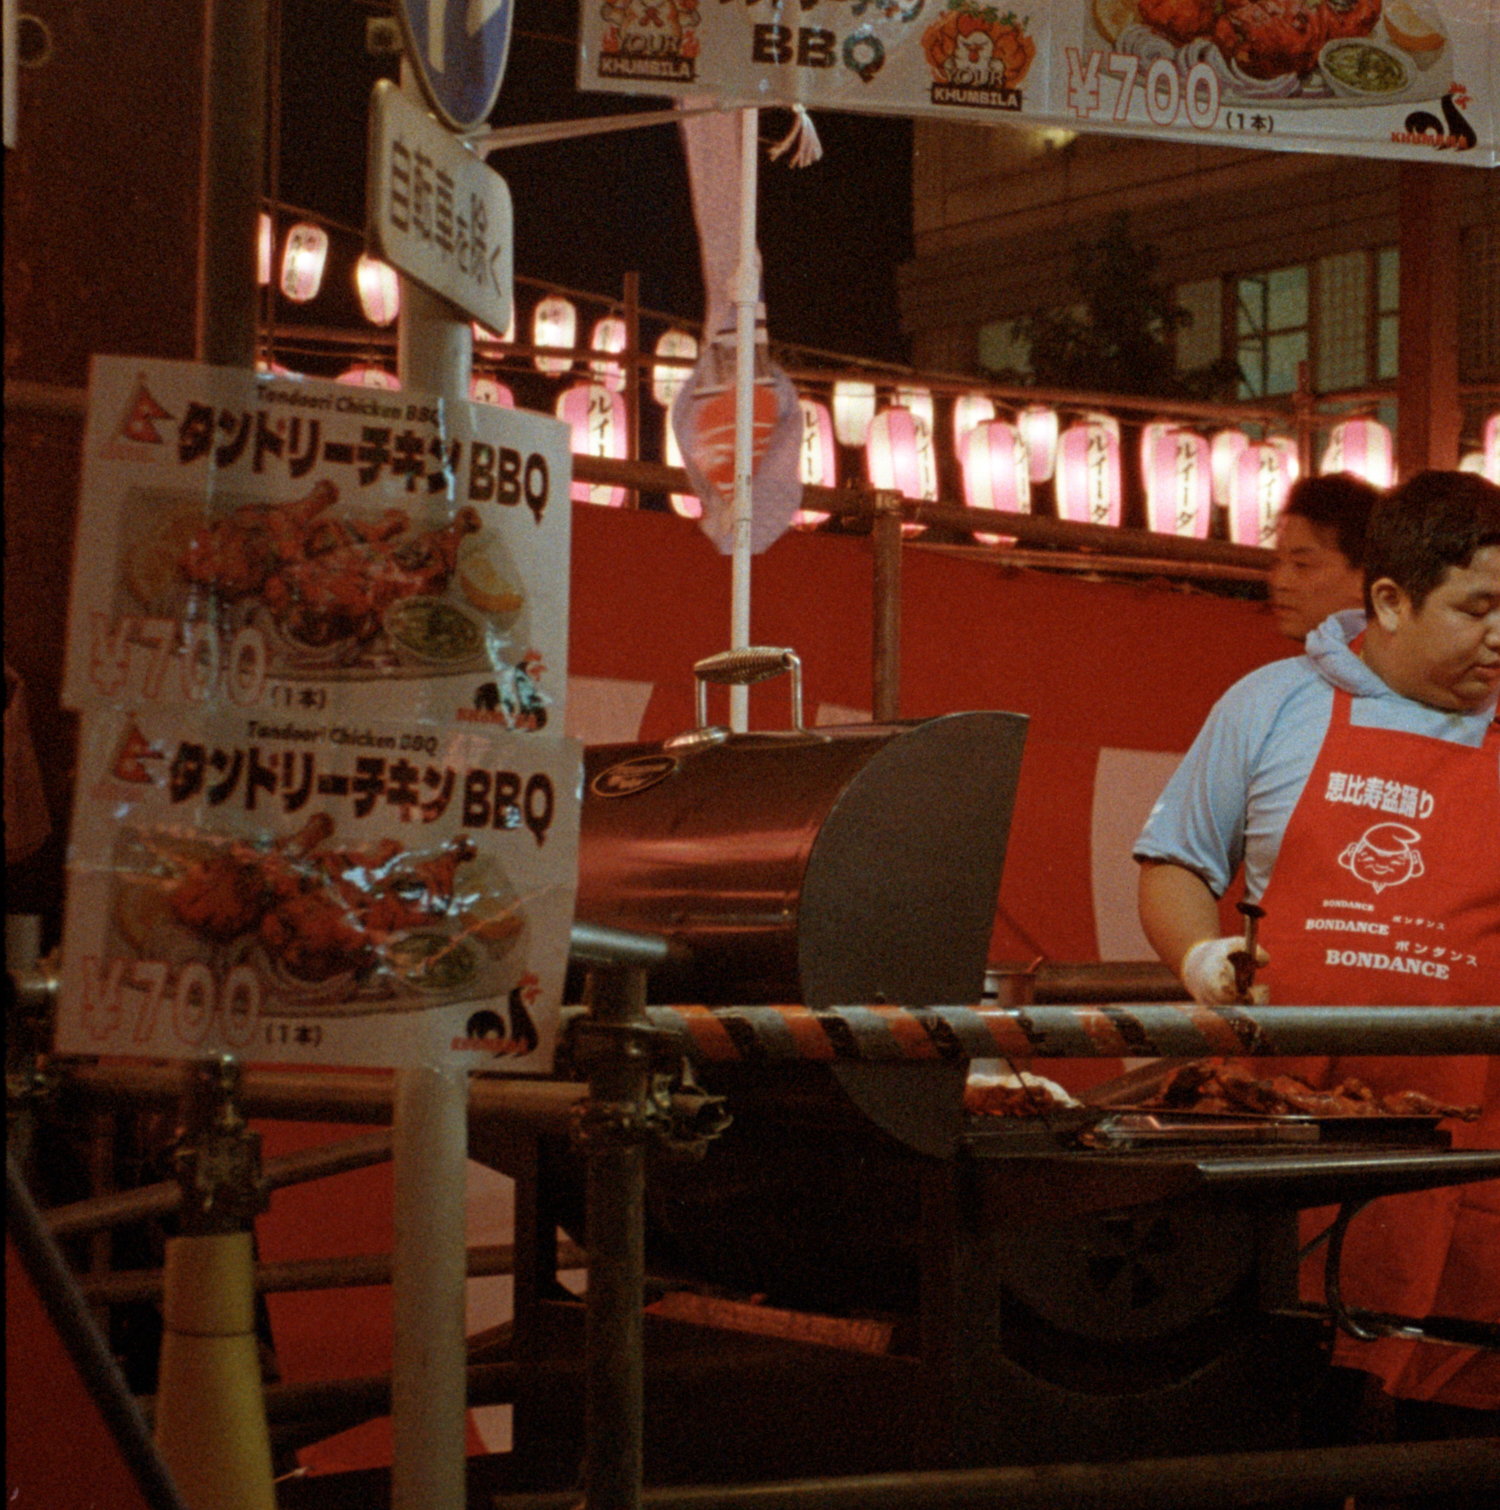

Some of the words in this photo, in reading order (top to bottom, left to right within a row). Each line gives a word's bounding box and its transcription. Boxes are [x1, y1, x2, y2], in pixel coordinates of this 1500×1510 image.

[752, 23, 886, 84] BBQ
[933, 86, 1019, 109] KHUMBILA
[1065, 46, 1221, 130] ¥700
[1225, 110, 1275, 135] (1本)
[256, 383, 333, 411] Tandoori
[335, 393, 401, 419] Chicken
[404, 403, 442, 428] BBQ
[177, 400, 462, 493] タンドリーチキン
[467, 441, 550, 526] BBQ
[328, 726, 395, 751] Chicken
[169, 740, 457, 824] タンドリーチキン
[461, 768, 555, 848] BBQ
[1324, 770, 1435, 820] 恵比寿盆踊り
[1322, 898, 1375, 912] BONDANCE
[1304, 917, 1390, 936] BONDANCE
[1325, 948, 1451, 981] BONDANCE
